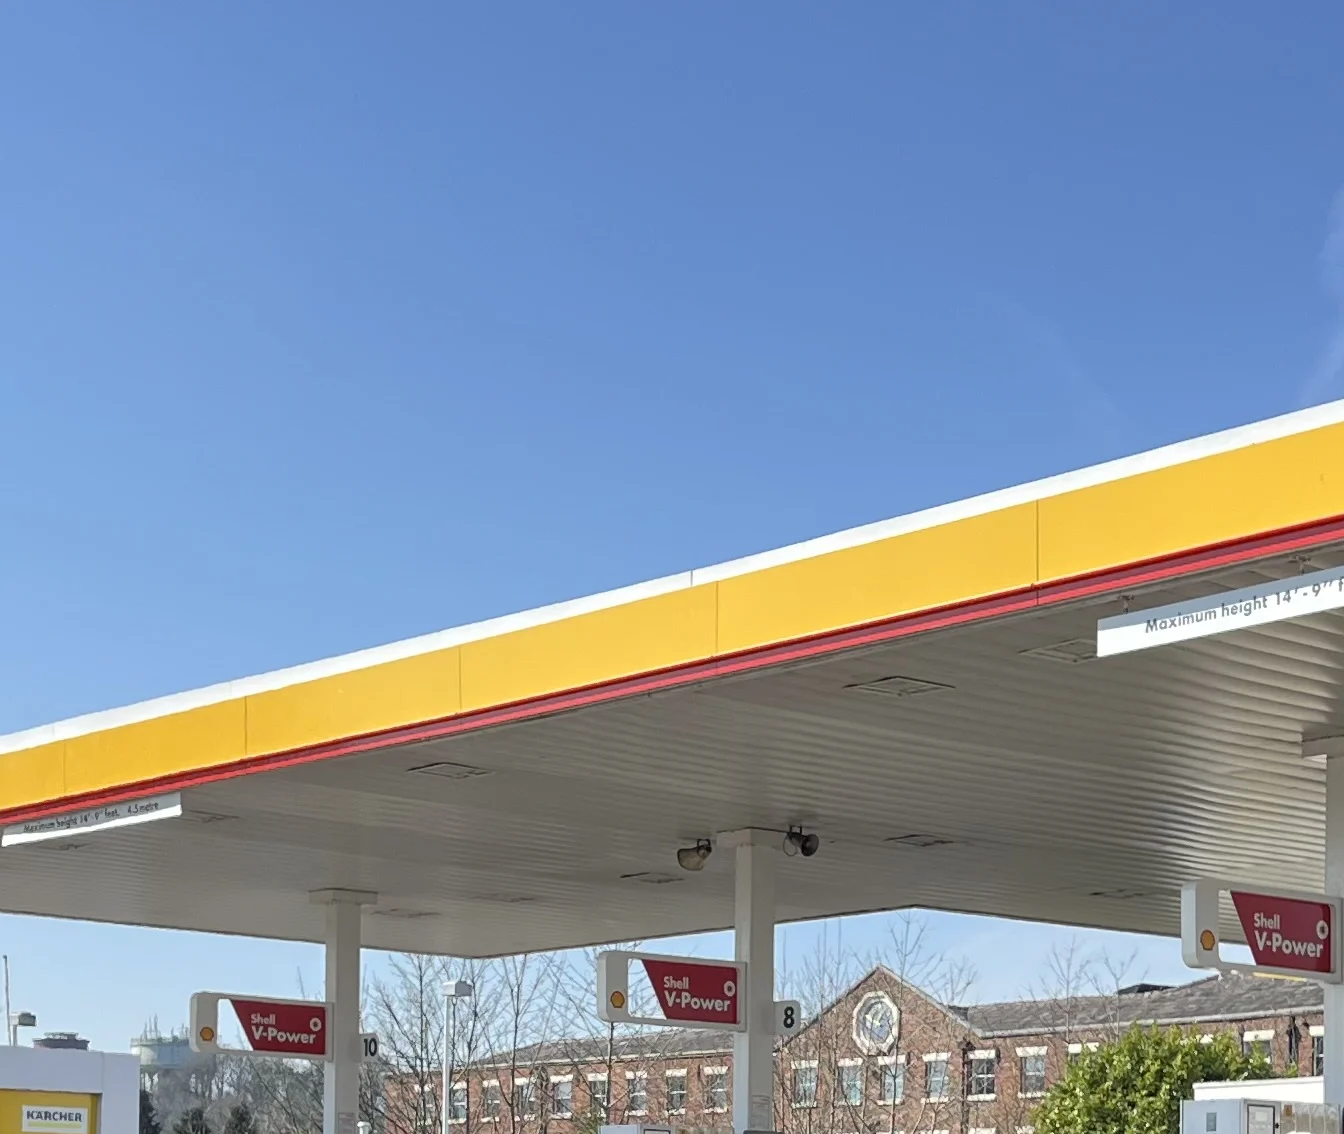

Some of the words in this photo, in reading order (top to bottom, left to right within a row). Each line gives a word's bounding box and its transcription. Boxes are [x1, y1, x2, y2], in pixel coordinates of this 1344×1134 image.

[1145, 608, 1217, 633] Maximum
[1221, 596, 1268, 617] height
[23, 820, 55, 833] Maximum
[56, 816, 78, 829] height
[1253, 912, 1281, 930] Shell
[1254, 930, 1324, 958] V-Power
[663, 975, 690, 990] Shell
[664, 990, 731, 1012] V-Power
[250, 1012, 276, 1025] Shell
[783, 1006, 795, 1029] 8
[251, 1026, 317, 1044] V-Power
[363, 1037, 378, 1057] 10
